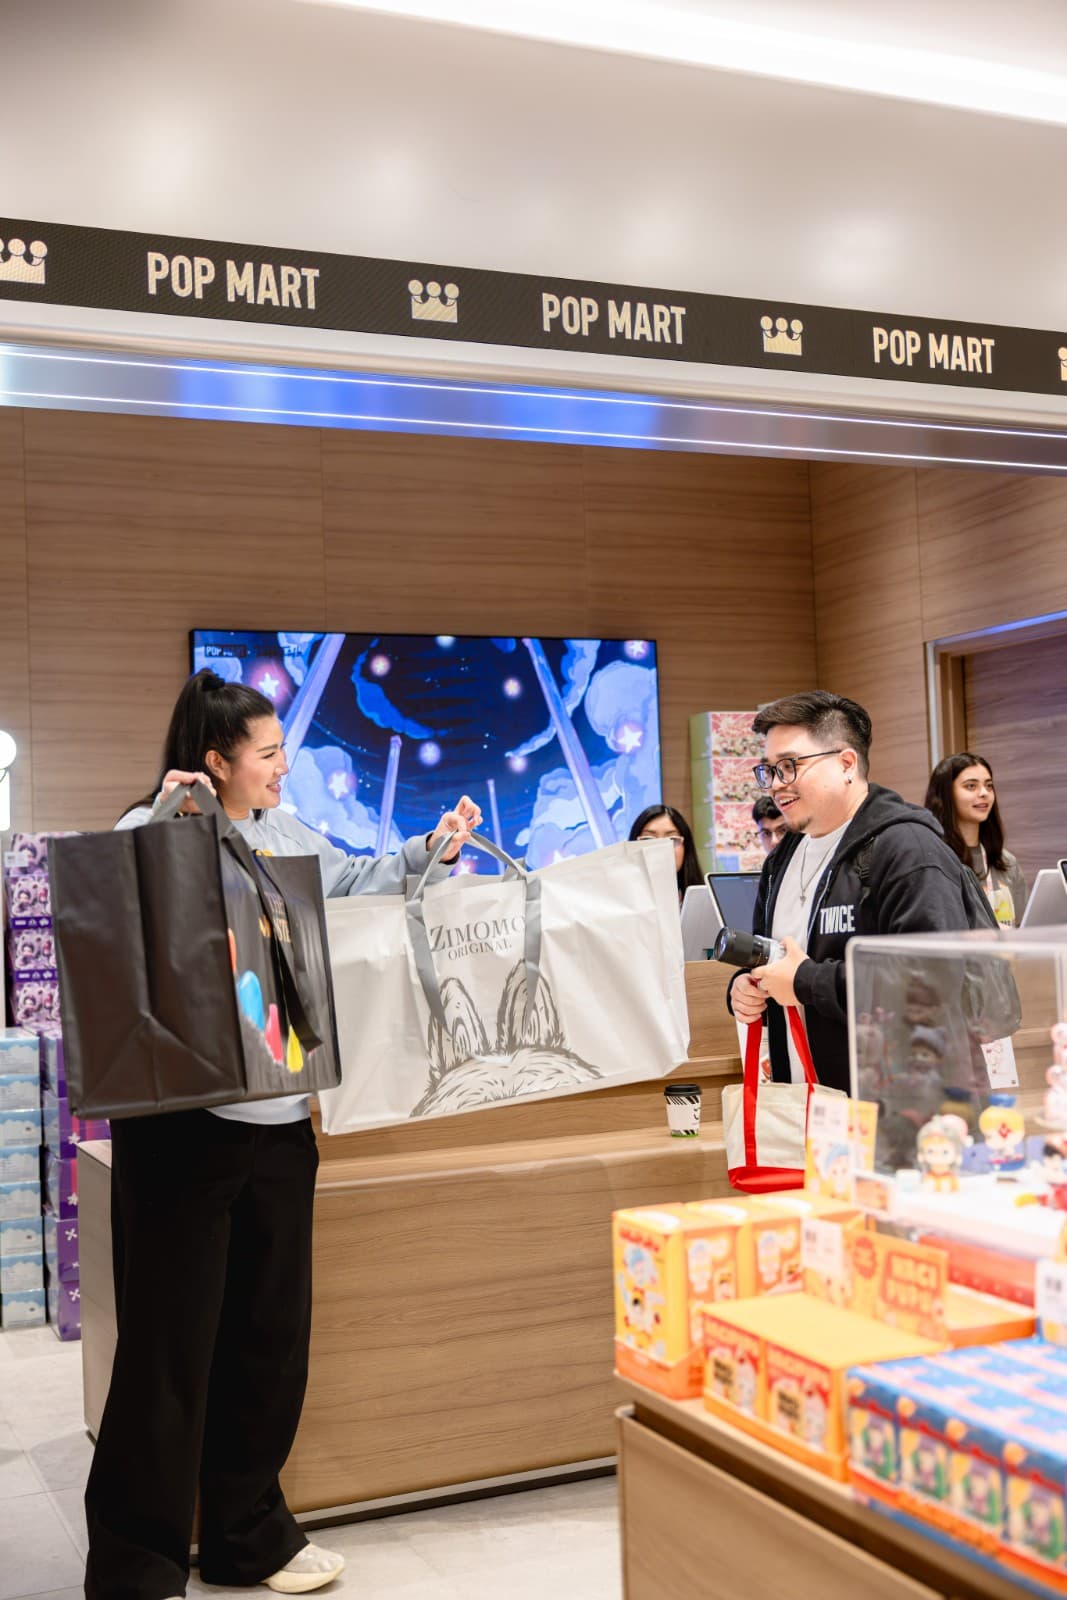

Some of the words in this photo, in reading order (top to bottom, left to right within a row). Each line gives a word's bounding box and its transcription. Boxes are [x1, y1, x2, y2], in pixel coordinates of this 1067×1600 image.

[147, 251, 216, 300] POP
[226, 259, 320, 310] MART
[542, 292, 600, 337] POP
[607, 299, 687, 345] MART
[872, 326, 922, 367] POP
[928, 332, 995, 374] MART
[430, 914, 526, 952] ZIMOMO
[820, 904, 856, 935] TWICE
[448, 938, 512, 961] ORIGINAL
